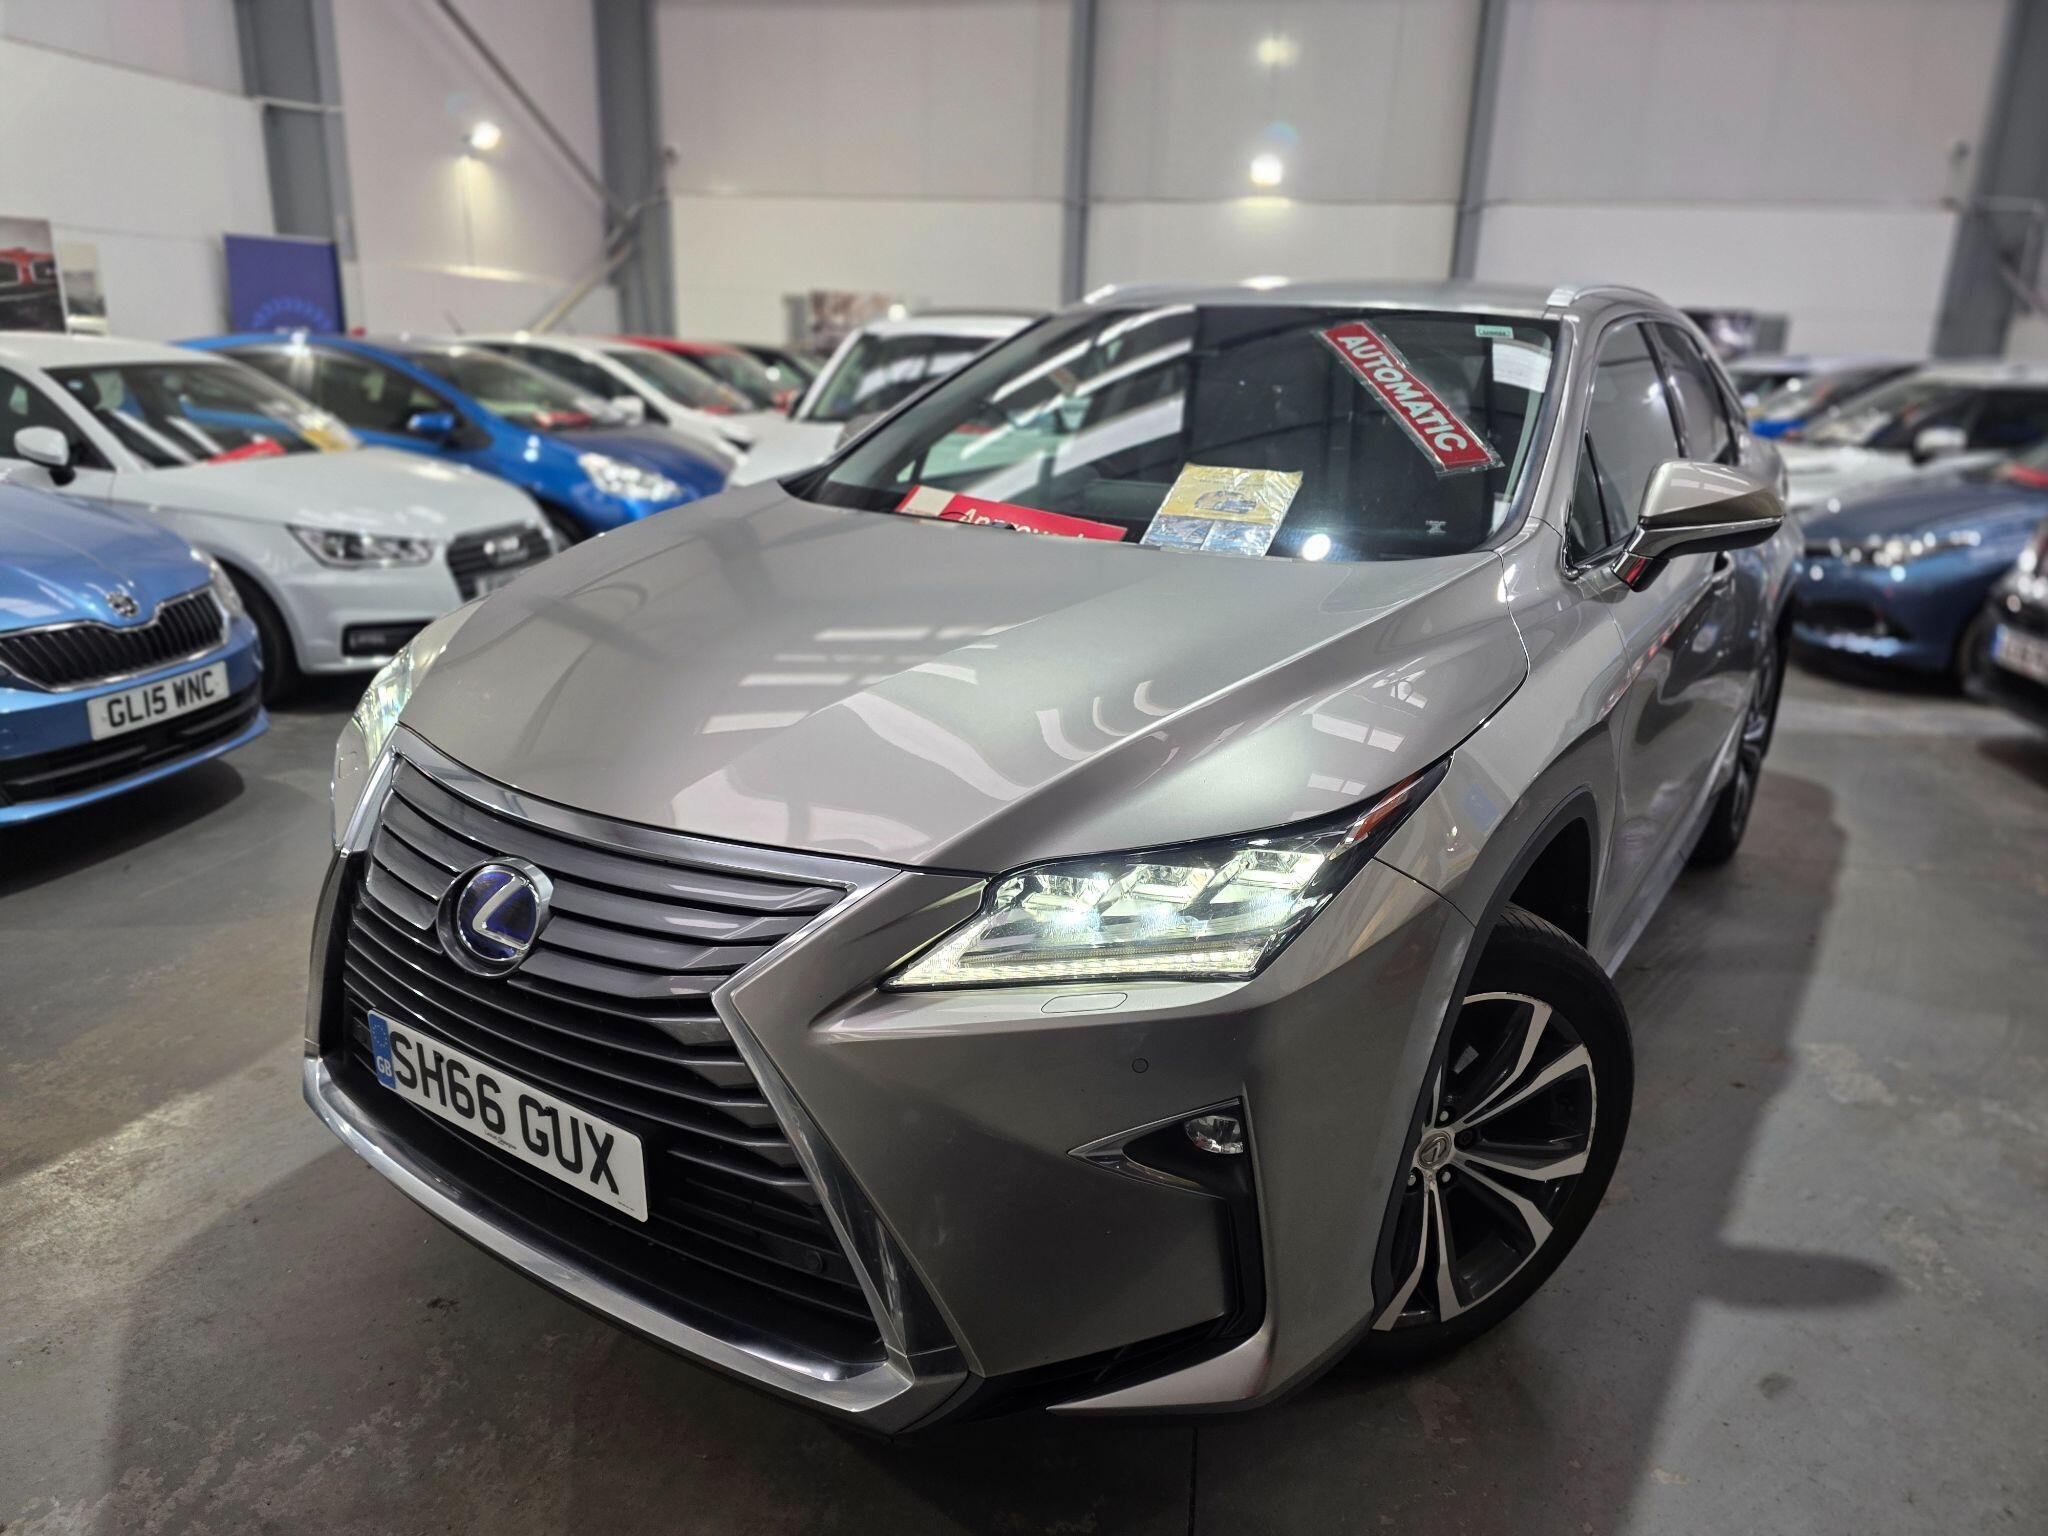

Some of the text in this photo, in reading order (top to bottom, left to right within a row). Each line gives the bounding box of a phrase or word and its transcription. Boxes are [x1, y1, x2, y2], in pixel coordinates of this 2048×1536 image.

[1337, 336, 1468, 452] AUTOMATIC
[107, 671, 215, 728] GL15 WNC
[376, 1055, 393, 1078] GB
[390, 1031, 620, 1196] SH66 GUX
